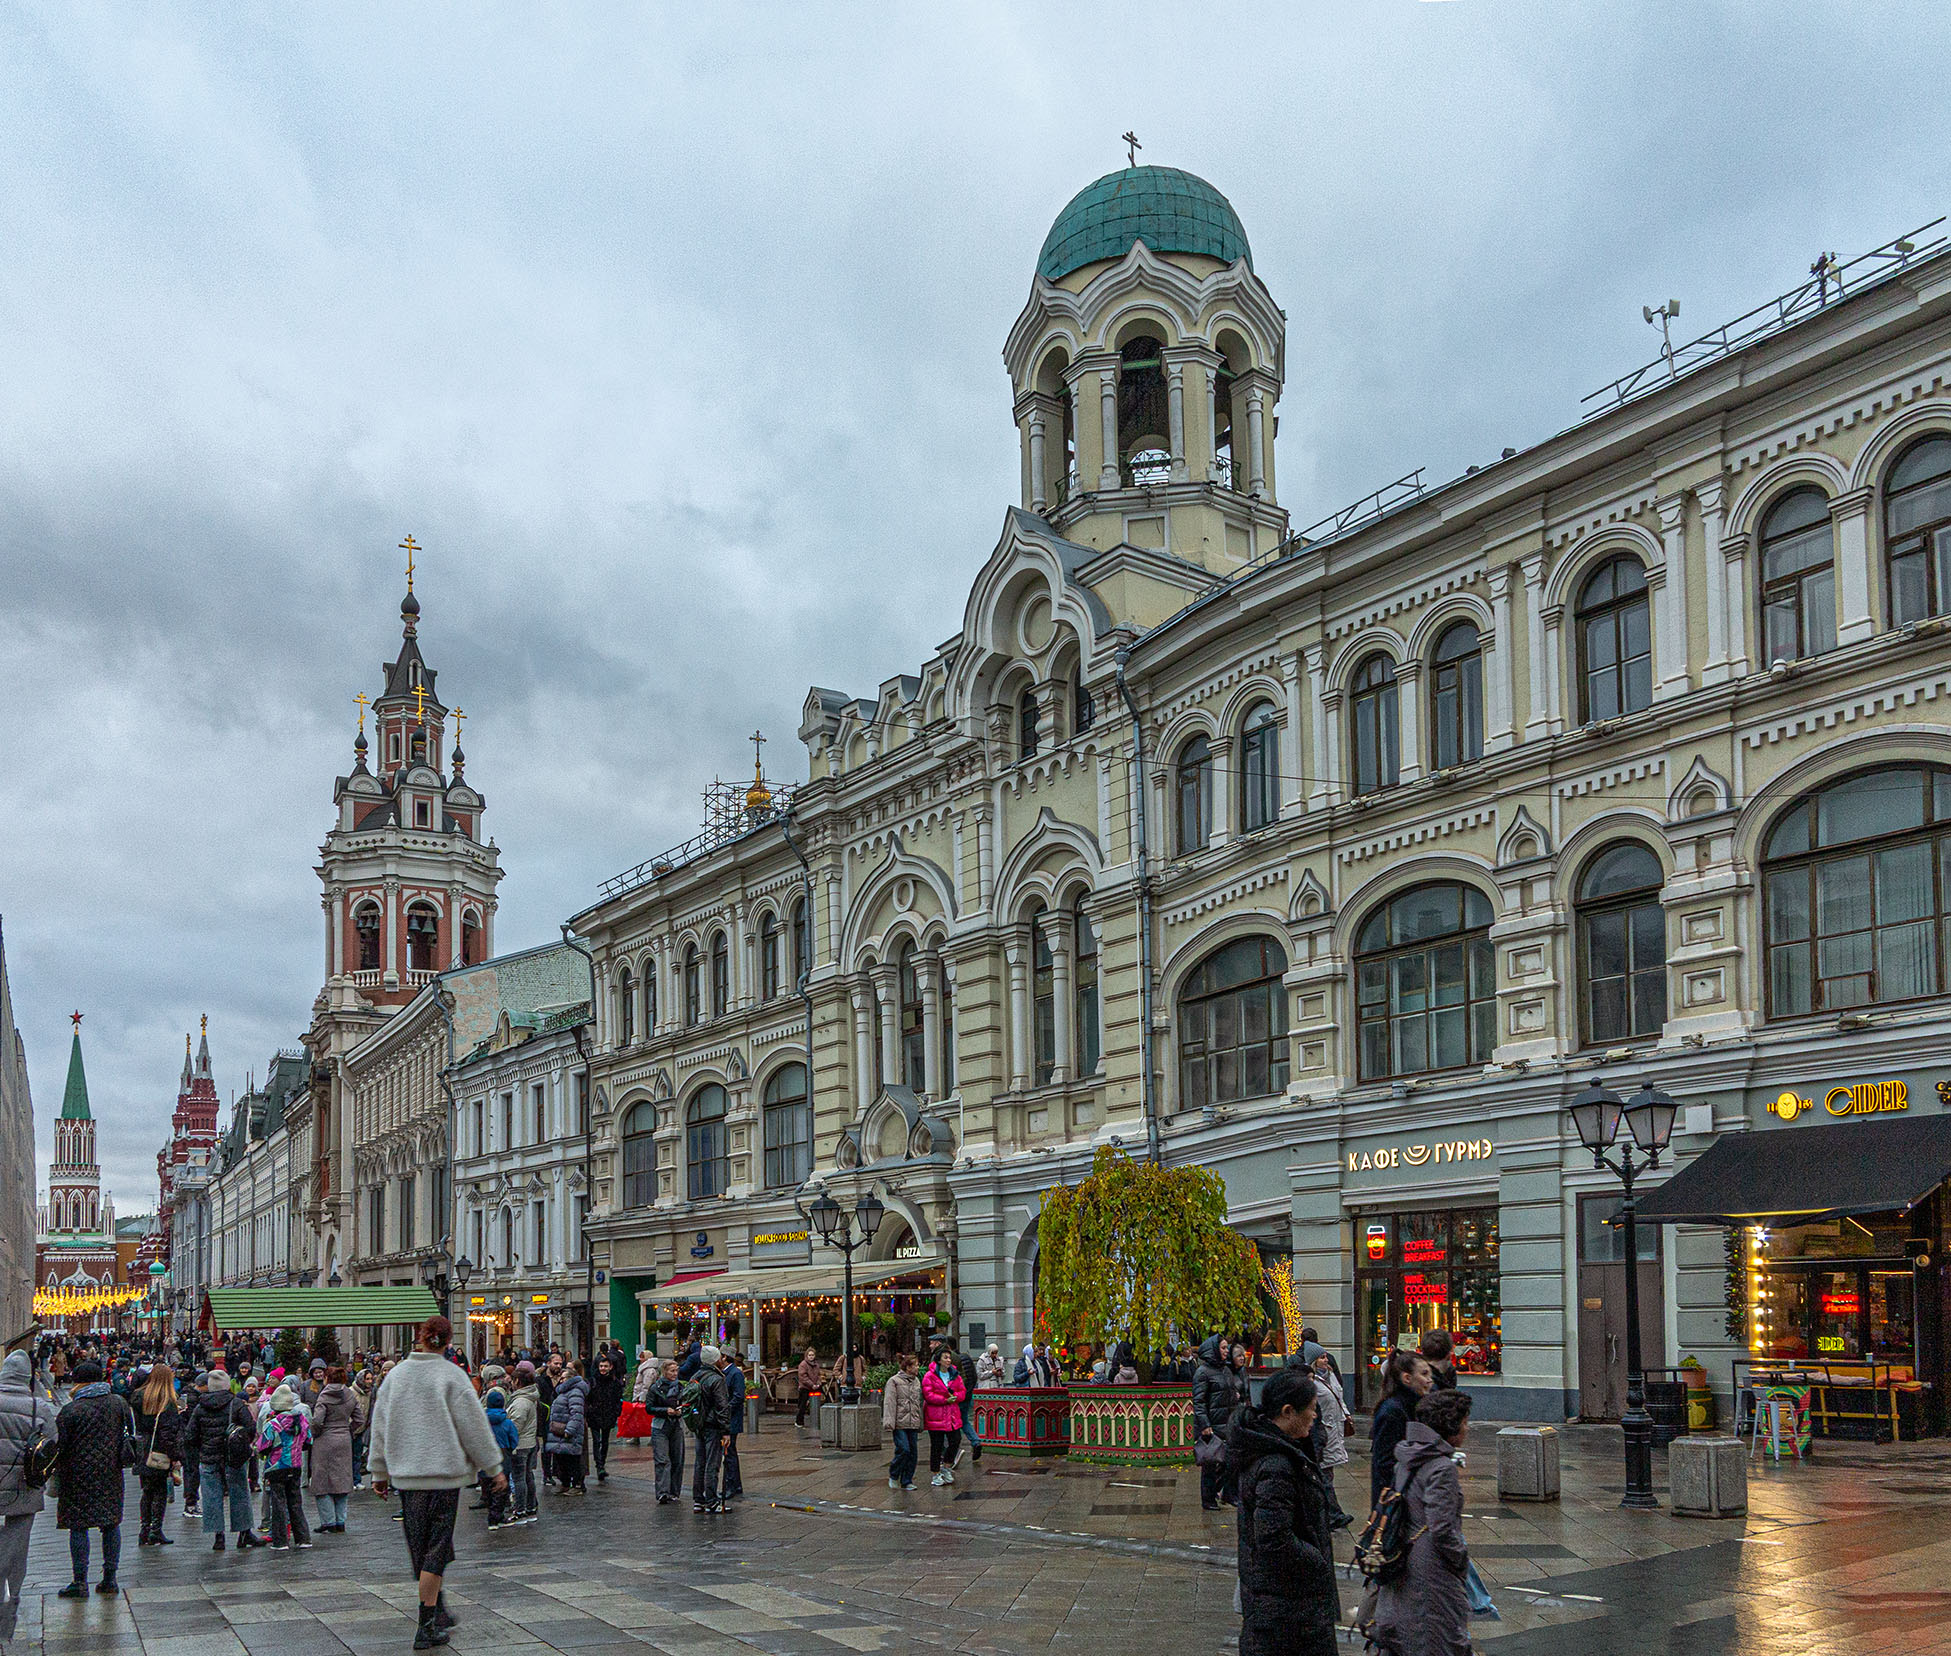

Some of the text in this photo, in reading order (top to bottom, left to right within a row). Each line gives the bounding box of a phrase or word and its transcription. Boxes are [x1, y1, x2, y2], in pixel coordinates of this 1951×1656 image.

[1824, 1080, 1908, 1116] CIDER
[1349, 1138, 1493, 1171] КАФЕ ГУРМЭ
[1404, 1240, 1434, 1251] COFFEE
[896, 1247, 902, 1258] IL
[1404, 1250, 1446, 1263] BREAKFAST
[1404, 1284, 1447, 1295] COCKTAILS
